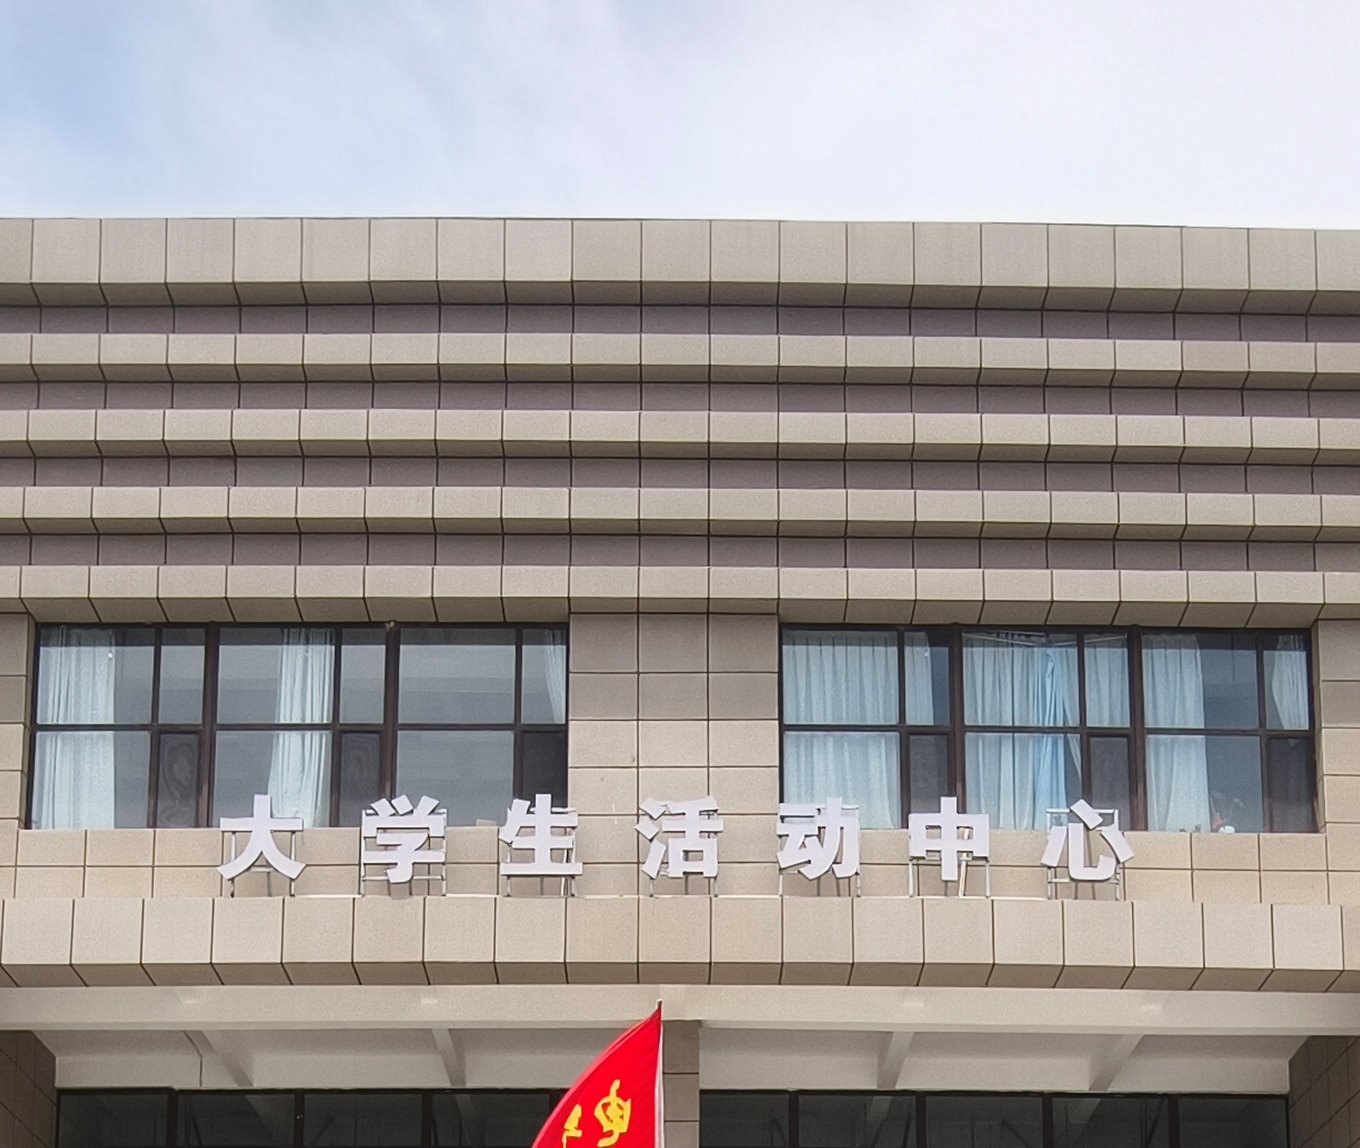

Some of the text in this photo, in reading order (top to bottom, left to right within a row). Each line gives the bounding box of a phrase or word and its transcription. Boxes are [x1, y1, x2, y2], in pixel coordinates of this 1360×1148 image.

[216, 794, 1135, 884] 大学生活动中心
